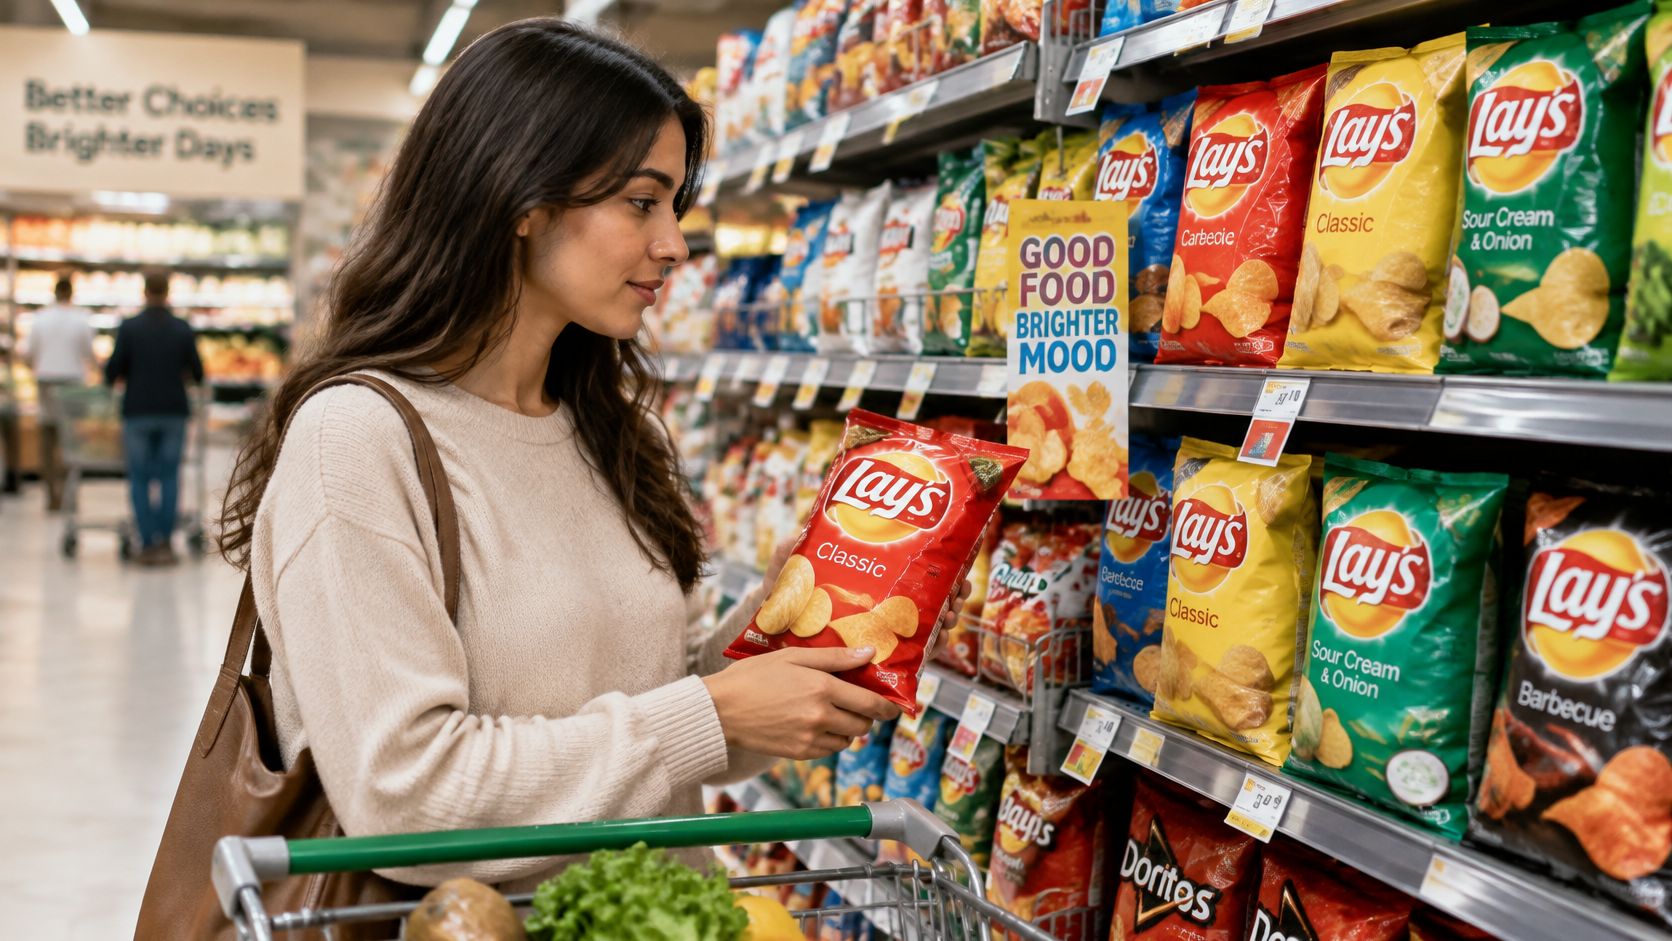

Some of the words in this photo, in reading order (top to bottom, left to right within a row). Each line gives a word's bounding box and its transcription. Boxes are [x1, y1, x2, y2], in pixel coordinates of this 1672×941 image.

[25, 79, 130, 113] Better
[143, 84, 279, 121] Choices
[1321, 104, 1412, 168] Lay's
[1469, 87, 1576, 159] Lay's
[26, 121, 163, 165] Brighter
[176, 129, 254, 170] Days
[1186, 136, 1264, 190] Lay's
[1316, 213, 1374, 234] Classic
[1462, 210, 1494, 229] Sour
[1495, 207, 1554, 228] Cream
[1020, 235, 1115, 269] GOOD
[1470, 233, 1481, 250] &
[1482, 231, 1532, 250] Onion
[1020, 270, 1115, 307] FOOD
[1016, 308, 1119, 339] BRIGHTER
[1019, 339, 1117, 374] MOOD
[832, 459, 947, 520] Lay's
[1171, 501, 1242, 566] Lay's
[816, 542, 886, 578] Classic
[1322, 531, 1424, 606] Lay's
[1170, 597, 1219, 629] Classic
[1528, 552, 1663, 640] Lay's
[1312, 640, 1343, 664] Sour
[1344, 650, 1400, 682] Cream
[1320, 667, 1330, 684] &
[1332, 670, 1379, 699] Onion
[1518, 680, 1617, 732] Barbecue
[1121, 838, 1215, 921] Doritos
